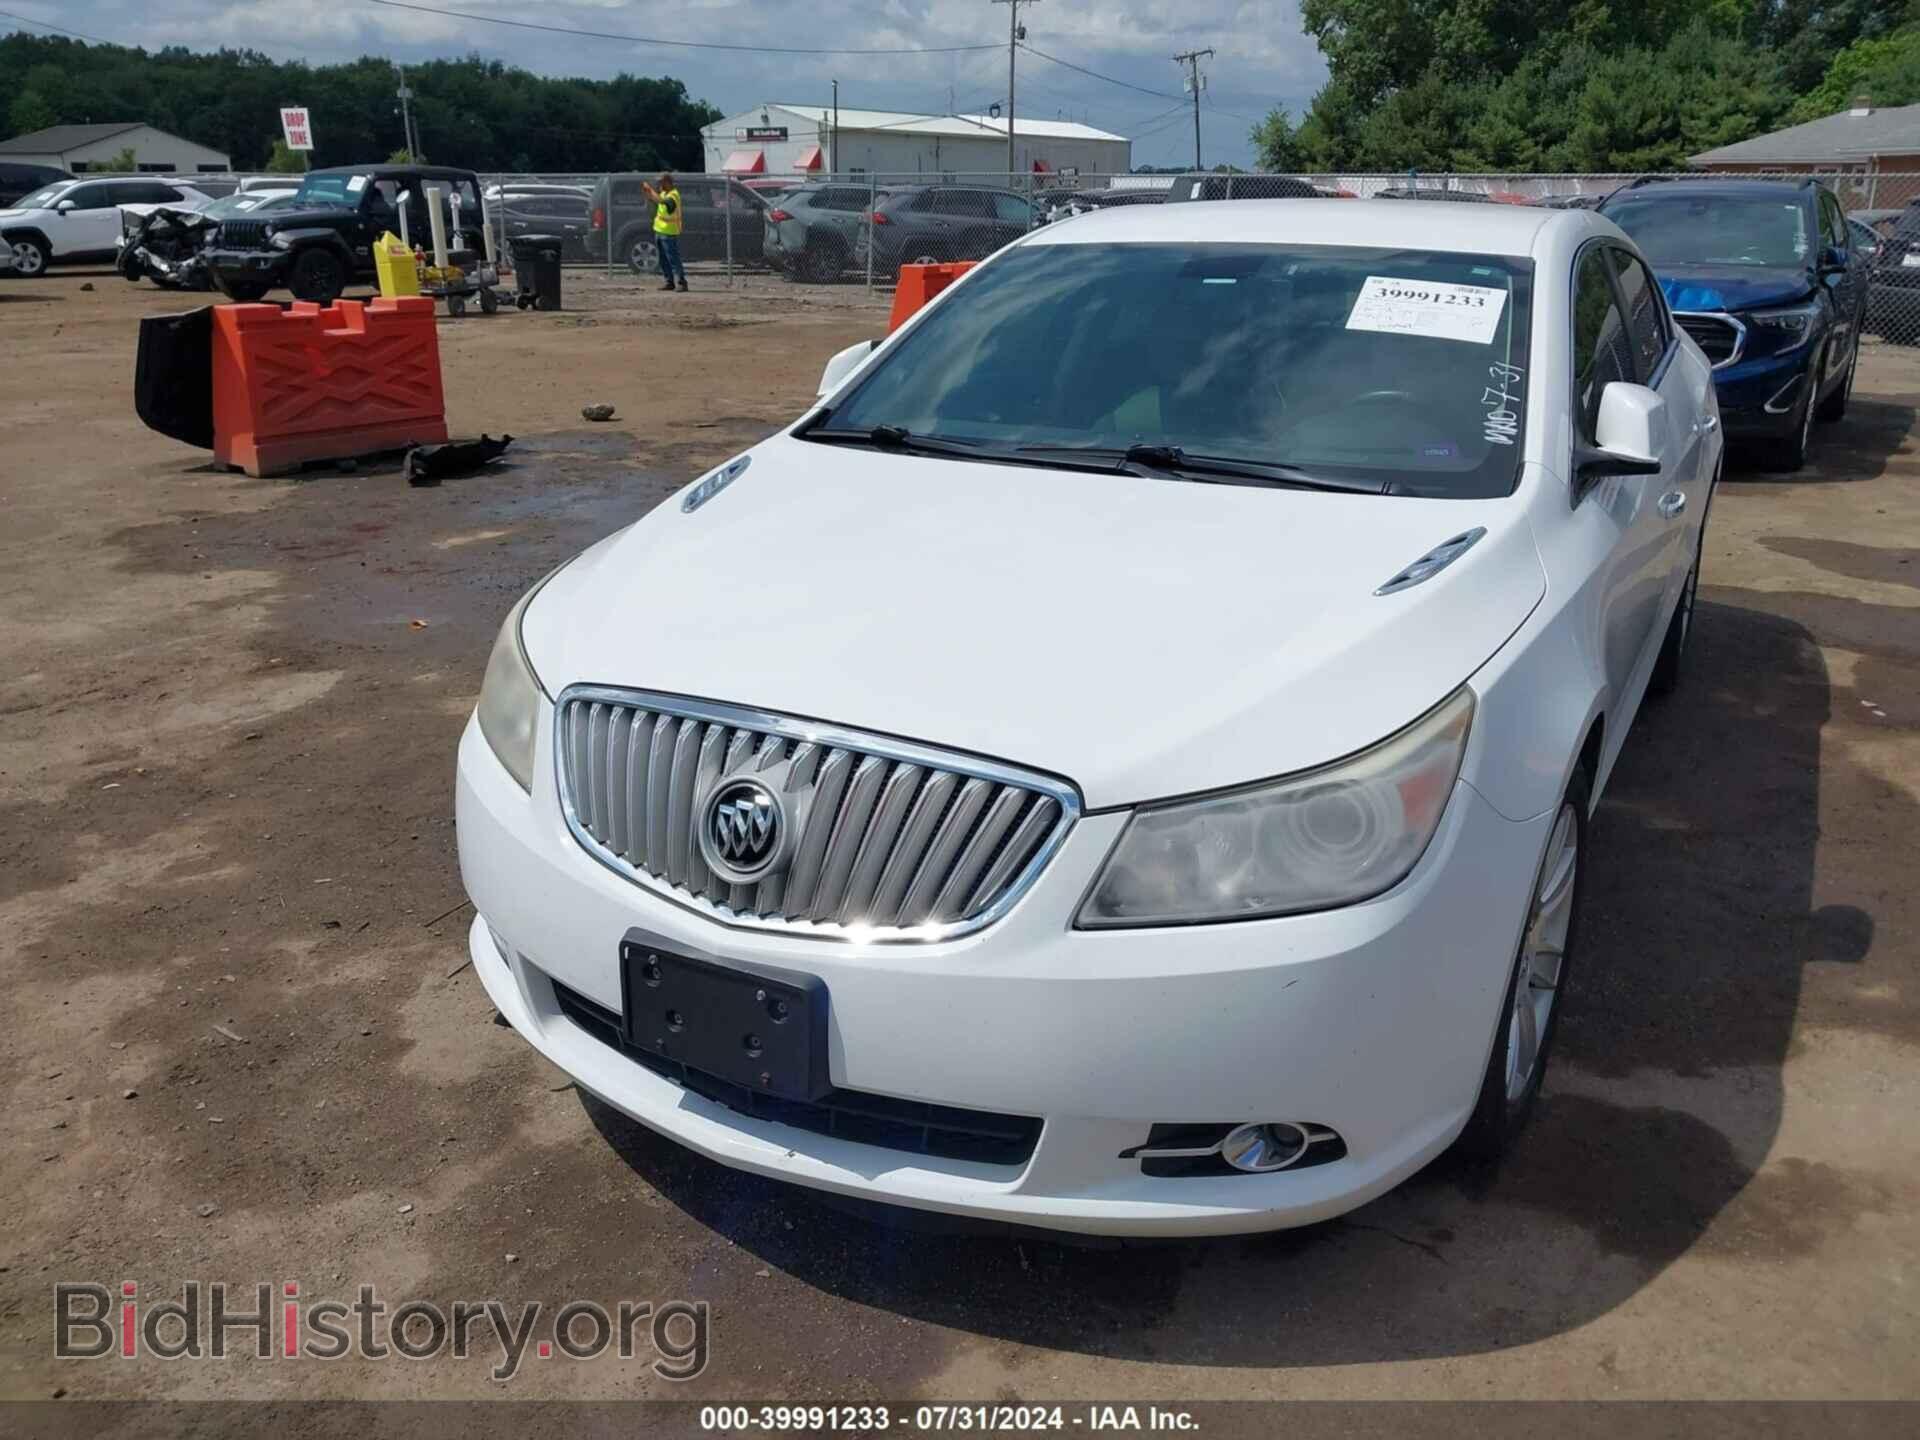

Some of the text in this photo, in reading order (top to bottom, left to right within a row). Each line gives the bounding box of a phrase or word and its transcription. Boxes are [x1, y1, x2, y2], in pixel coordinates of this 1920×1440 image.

[284, 112, 305, 127] DROP
[289, 130, 308, 145] ZONE
[1375, 287, 1486, 308] 39991233
